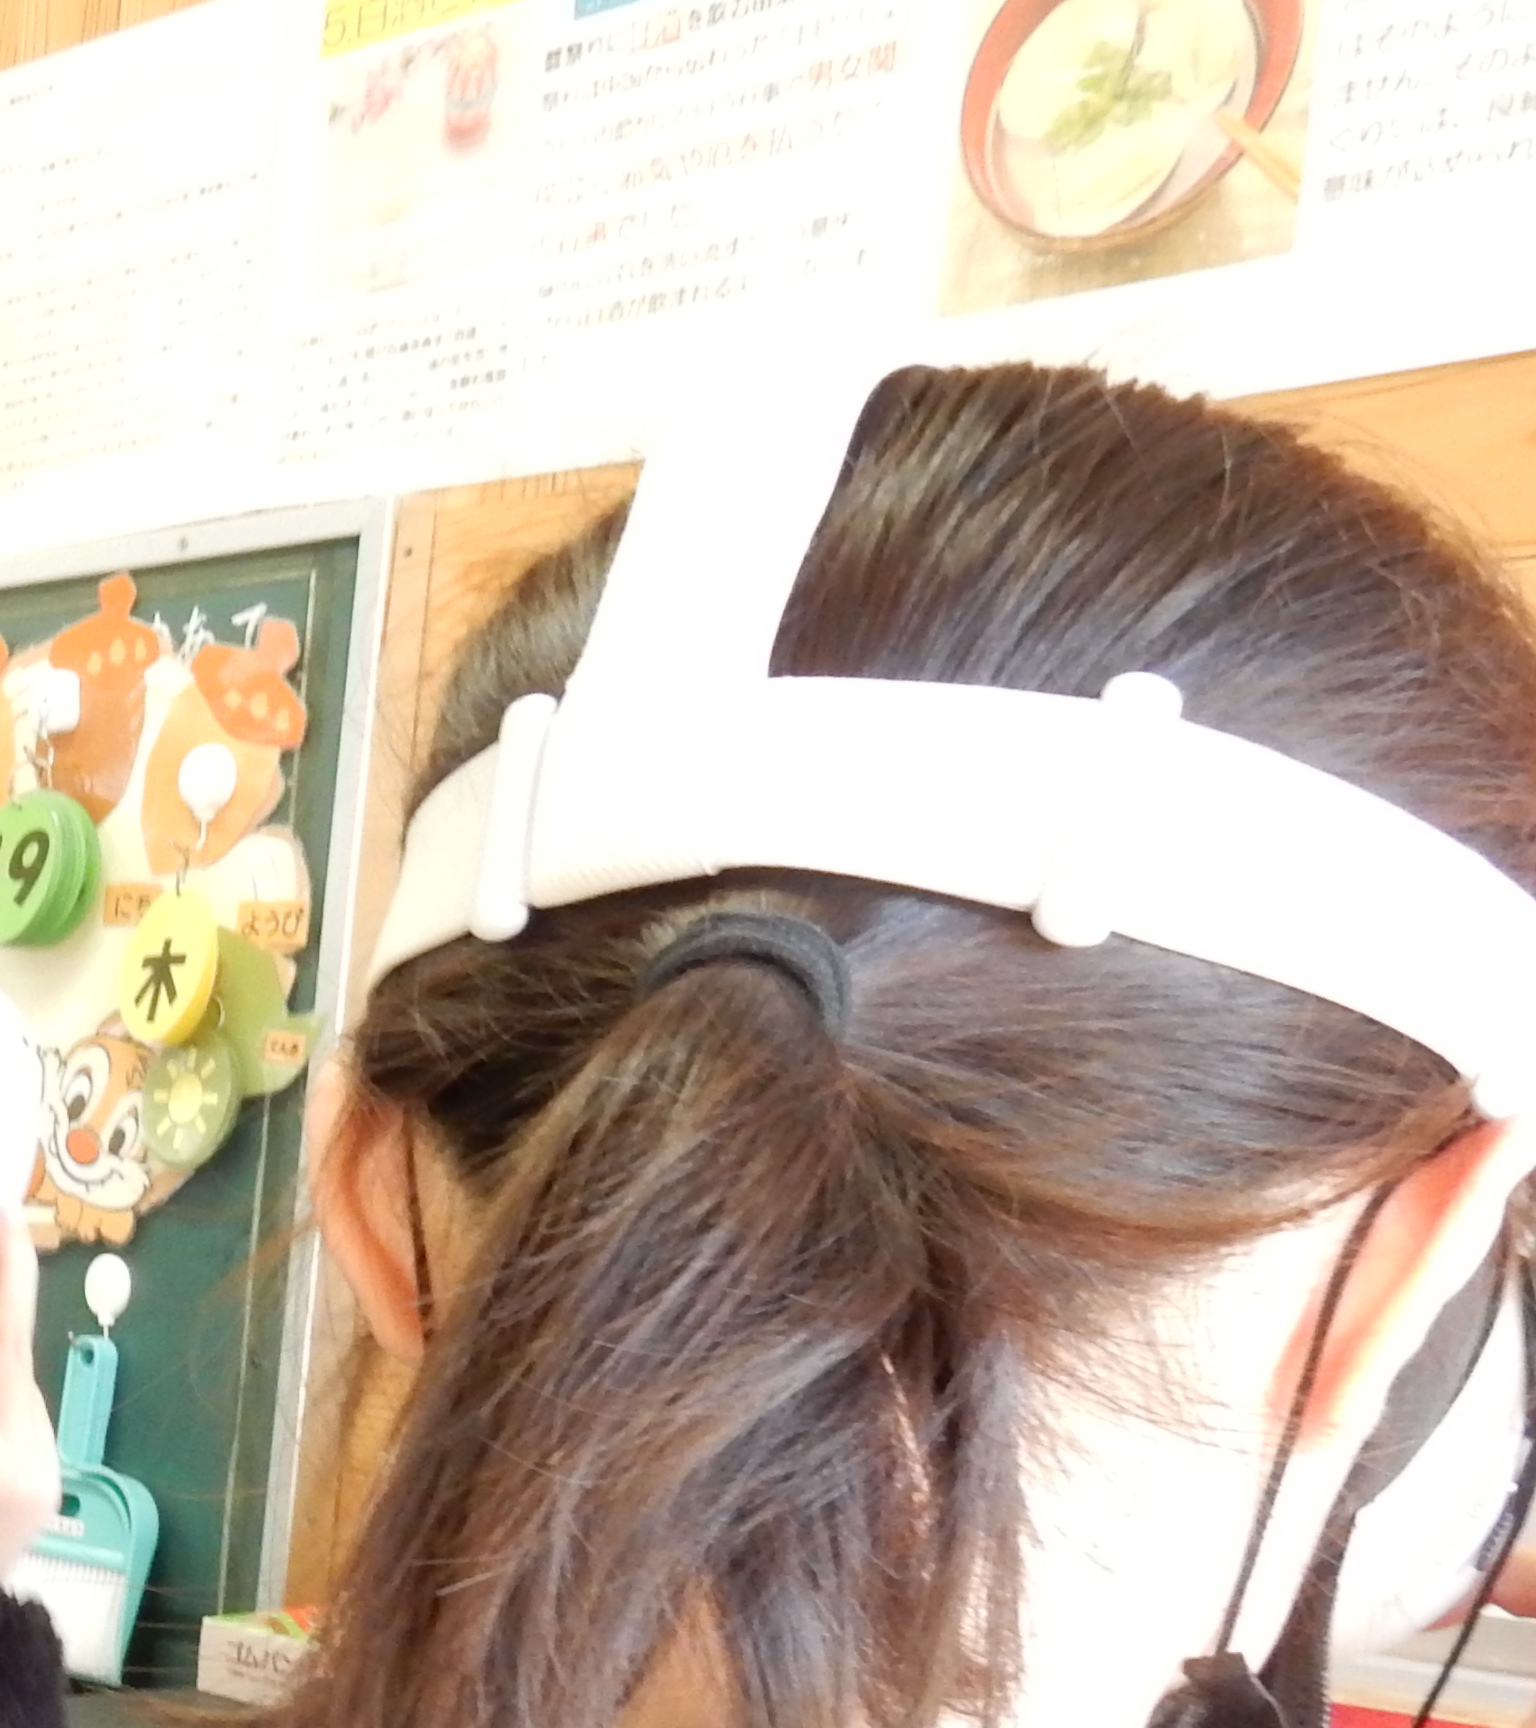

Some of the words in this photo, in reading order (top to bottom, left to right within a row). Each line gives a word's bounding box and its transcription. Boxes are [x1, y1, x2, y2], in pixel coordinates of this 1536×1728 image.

[240, 908, 305, 939] ようび
[133, 937, 188, 1024] 木
